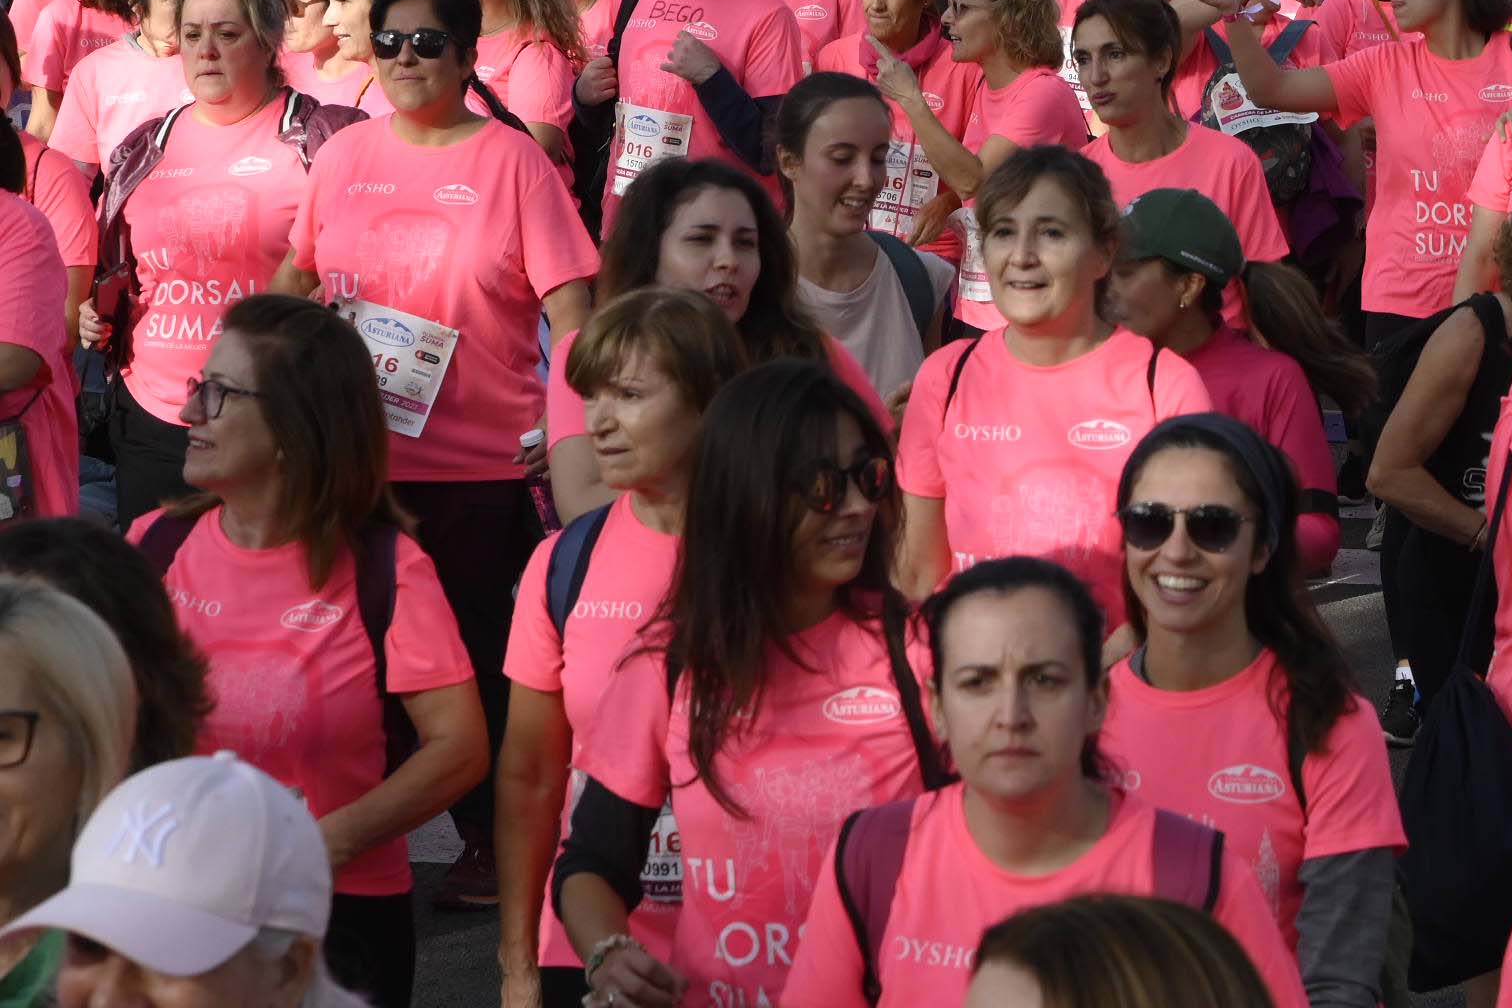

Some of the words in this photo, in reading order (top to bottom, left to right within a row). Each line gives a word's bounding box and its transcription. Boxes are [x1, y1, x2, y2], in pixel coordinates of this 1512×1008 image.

[649, 0, 704, 23] BEGO
[626, 142, 653, 159] 016
[149, 167, 193, 180] OYSHO
[1410, 169, 1439, 193] TU
[348, 182, 395, 194] OYSHO
[1415, 200, 1473, 225] DOR
[140, 247, 170, 274] TU
[328, 272, 360, 299] TU
[363, 323, 411, 347] ASTURIANA
[954, 423, 1022, 441] OYSHO
[574, 599, 643, 620] OYSHO
[831, 699, 895, 714] ASTURIANA
[1215, 778, 1278, 793] ASTURIANA
[687, 857, 736, 901] TU
